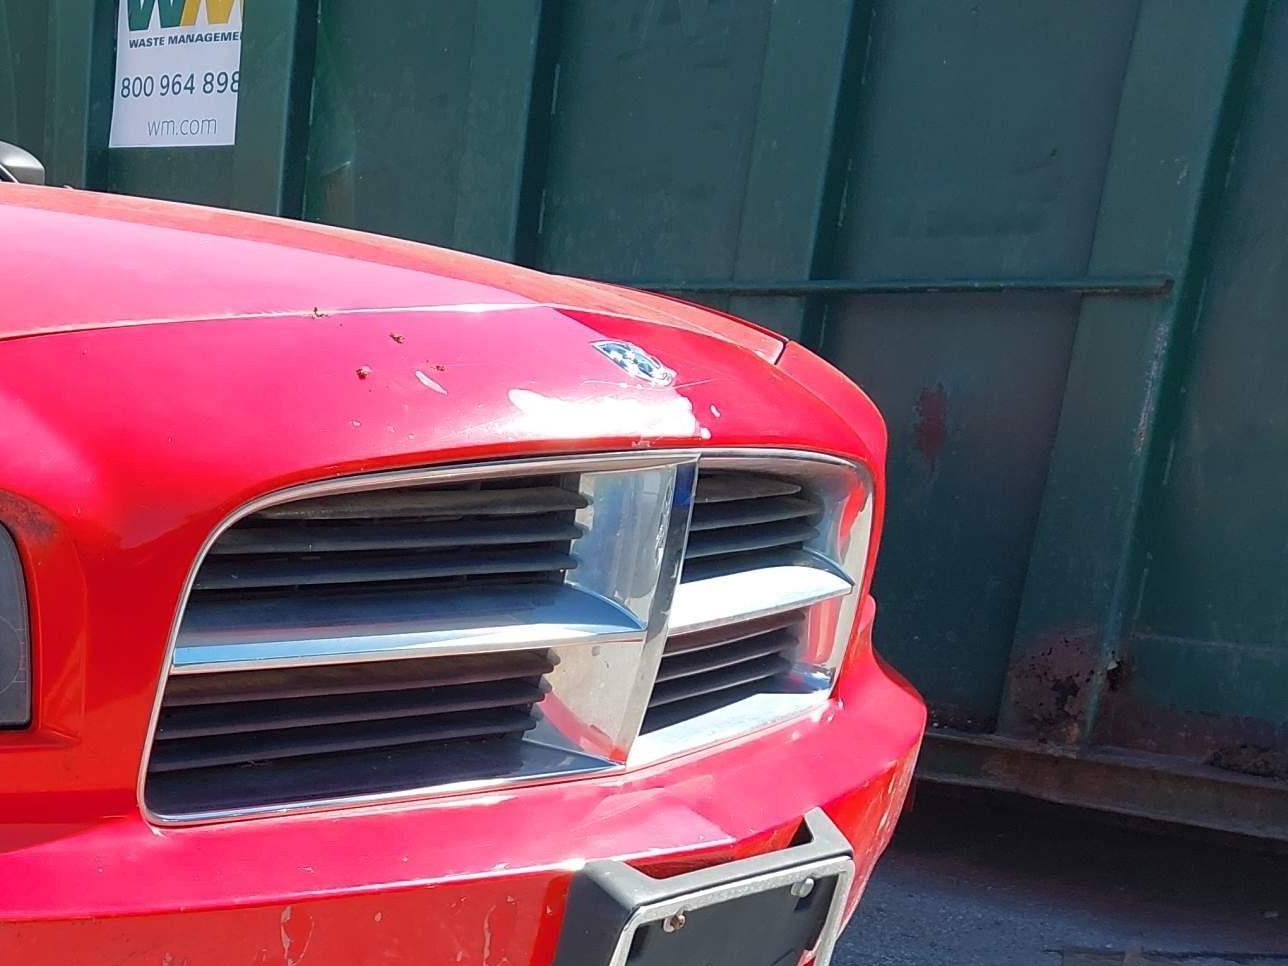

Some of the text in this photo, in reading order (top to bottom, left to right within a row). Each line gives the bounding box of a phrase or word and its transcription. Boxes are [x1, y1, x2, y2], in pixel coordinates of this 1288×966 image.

[129, 31, 241, 48] WASTE MANAGEME
[121, 76, 154, 98] 800
[159, 73, 195, 96] 964
[147, 118, 216, 137] wm.com
